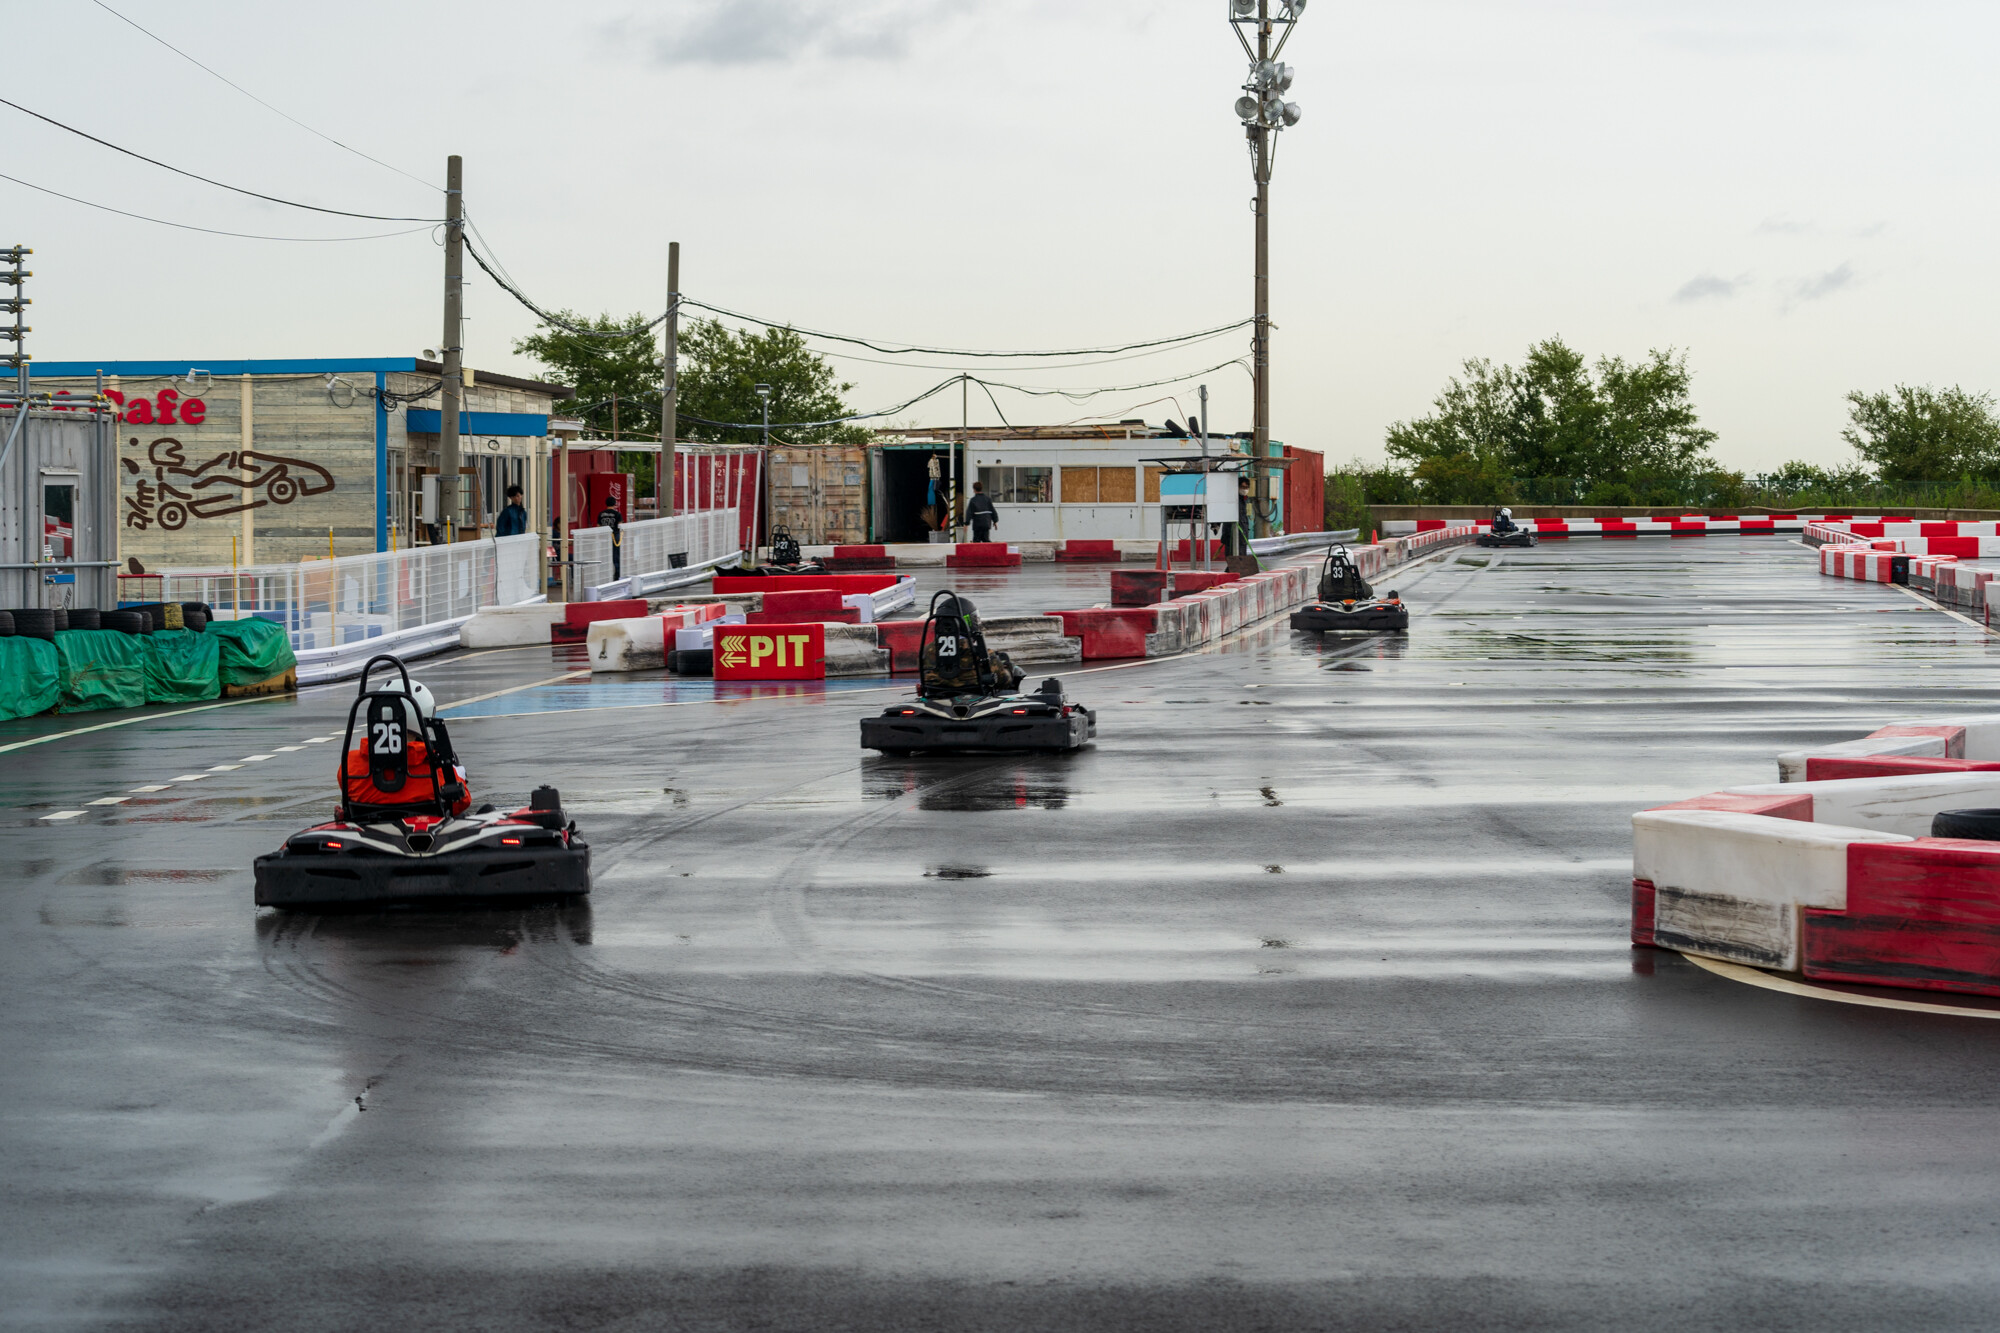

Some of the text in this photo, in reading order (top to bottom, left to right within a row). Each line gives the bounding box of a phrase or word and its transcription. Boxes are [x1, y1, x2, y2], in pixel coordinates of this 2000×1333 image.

[1333, 567, 1343, 579] 33
[750, 635, 810, 667] PIT
[938, 636, 957, 657] 29
[373, 723, 402, 754] 26
